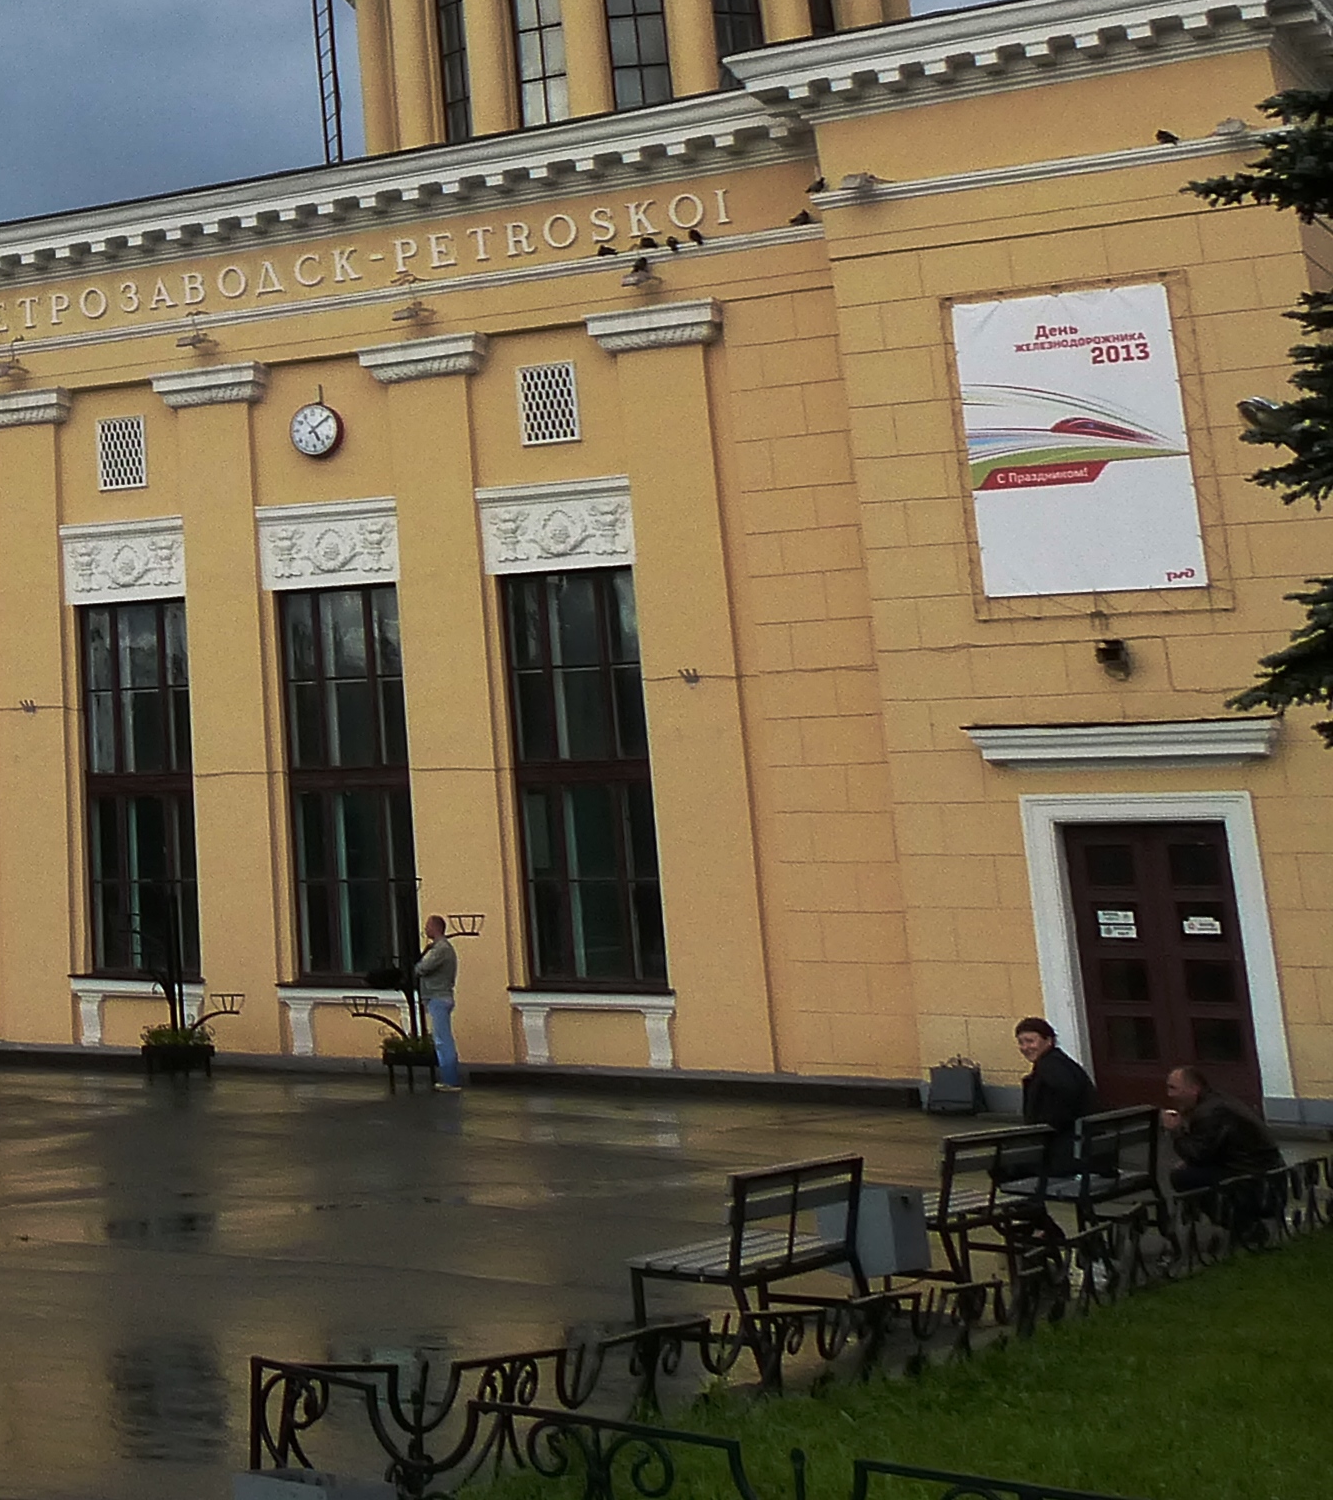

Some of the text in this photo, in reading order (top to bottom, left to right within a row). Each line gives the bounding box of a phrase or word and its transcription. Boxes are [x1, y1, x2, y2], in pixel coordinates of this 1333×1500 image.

[1034, 325, 1079, 341] День
[1090, 342, 1151, 364] 2013
[997, 473, 1006, 484] С
